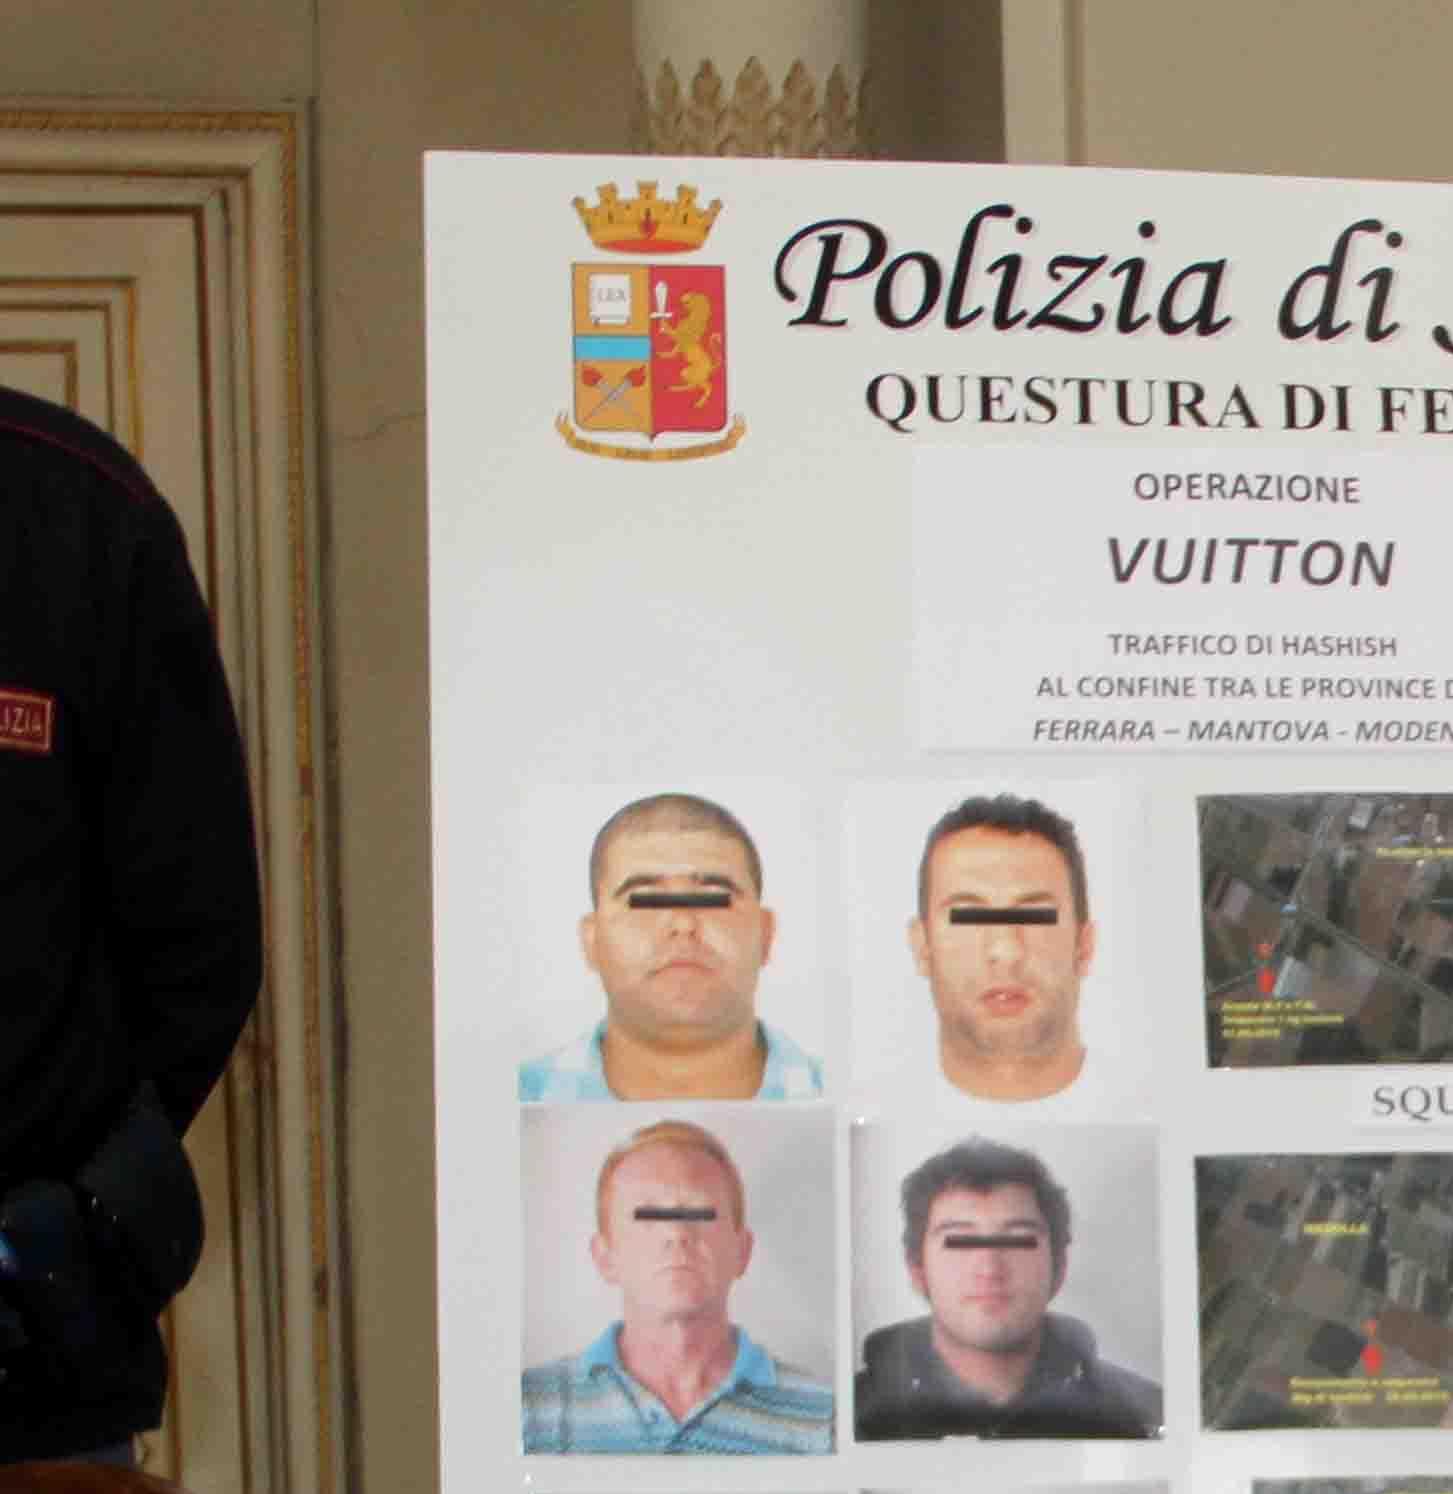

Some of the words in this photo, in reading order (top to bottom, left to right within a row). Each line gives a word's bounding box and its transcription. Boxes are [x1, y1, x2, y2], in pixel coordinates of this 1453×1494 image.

[773, 203, 1233, 338] Polizia
[1277, 218, 1403, 343] di
[865, 374, 1261, 433] QUESTURA
[1283, 383, 1350, 432] DI
[1133, 472, 1361, 505] OPERAZIONE
[1107, 536, 1396, 588] VUITTON
[1108, 633, 1238, 657] TRAFFICO
[1246, 634, 1273, 657] DI
[1281, 635, 1398, 658] HASHISH
[1036, 676, 1069, 698] AL
[1076, 676, 1196, 699] CONFINE
[1203, 676, 1257, 699] TRA
[1265, 676, 1292, 700] LE
[1301, 677, 1436, 701] PROVINCE
[1033, 719, 1155, 742] FERRARA
[1188, 719, 1329, 743] MANTOVA
